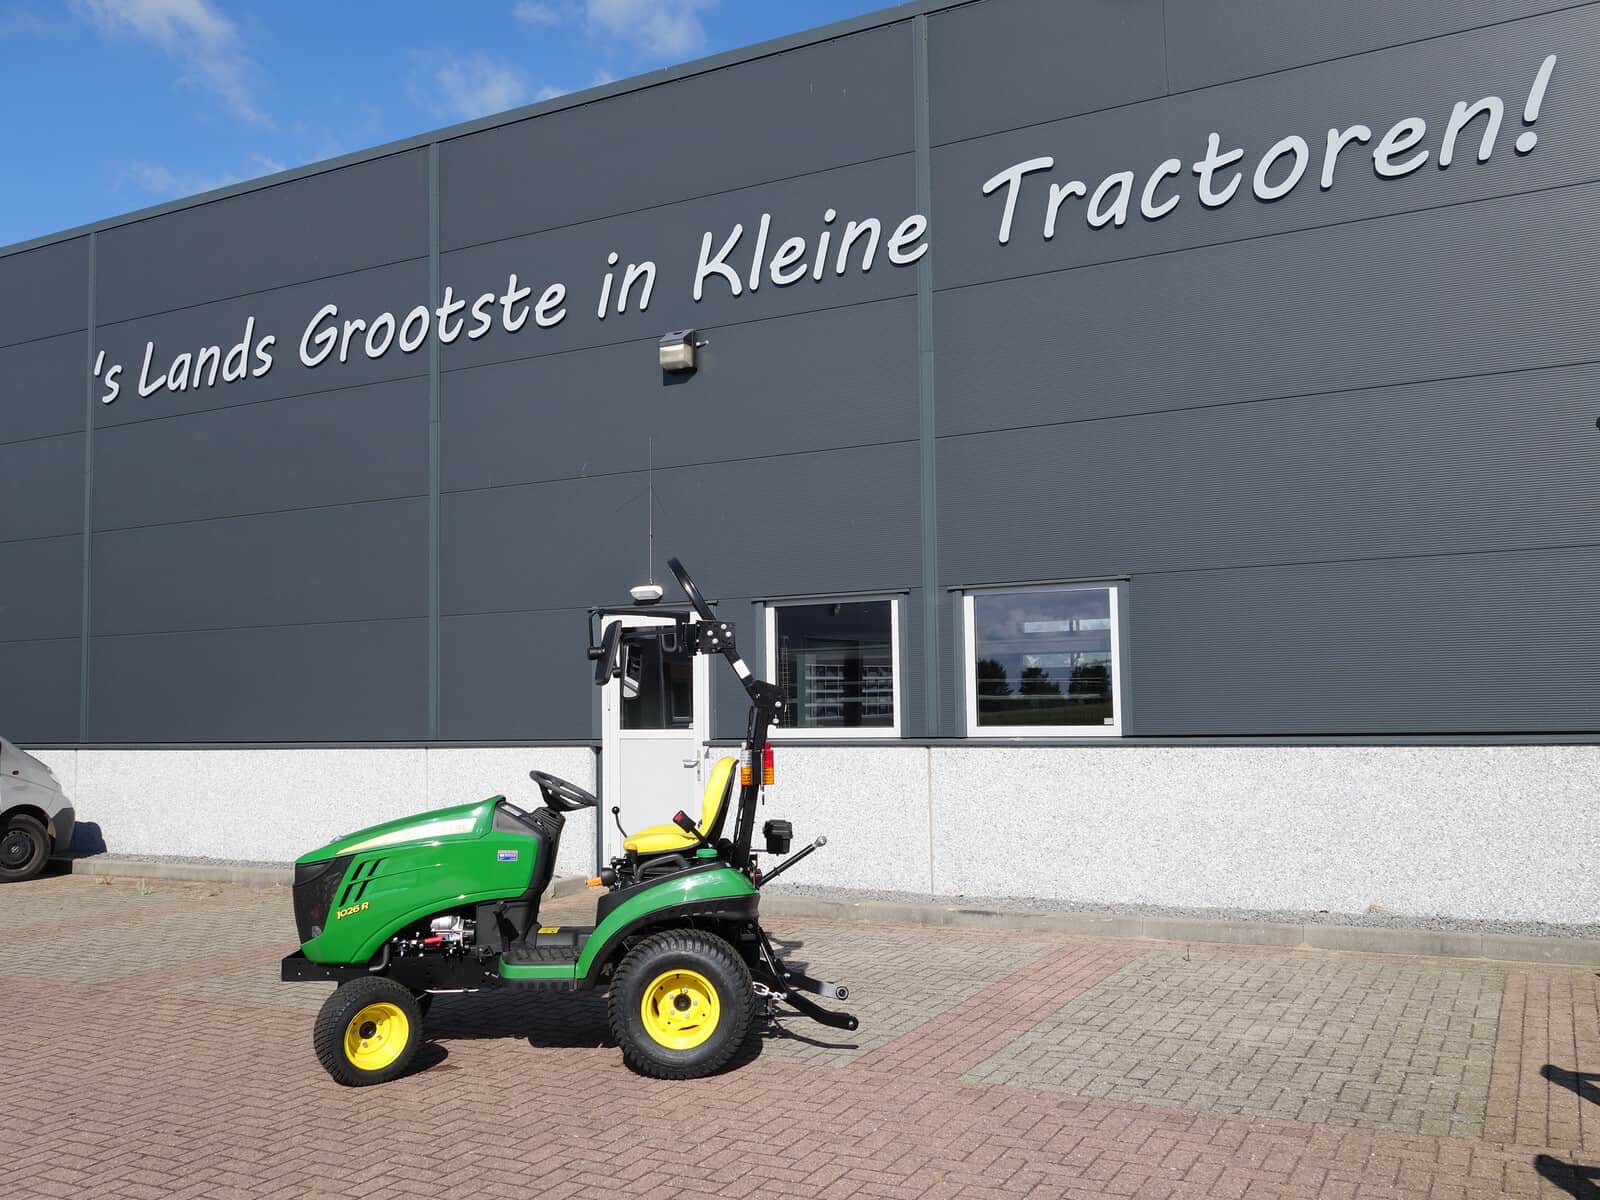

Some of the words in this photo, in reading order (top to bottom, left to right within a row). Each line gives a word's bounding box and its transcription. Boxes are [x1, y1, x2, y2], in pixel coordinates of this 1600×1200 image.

[138, 316, 276, 397] Lands
[299, 273, 567, 367] Grootste
[597, 251, 656, 319] in
[693, 208, 929, 301] Kleine
[982, 54, 1557, 244] Tractoren!
